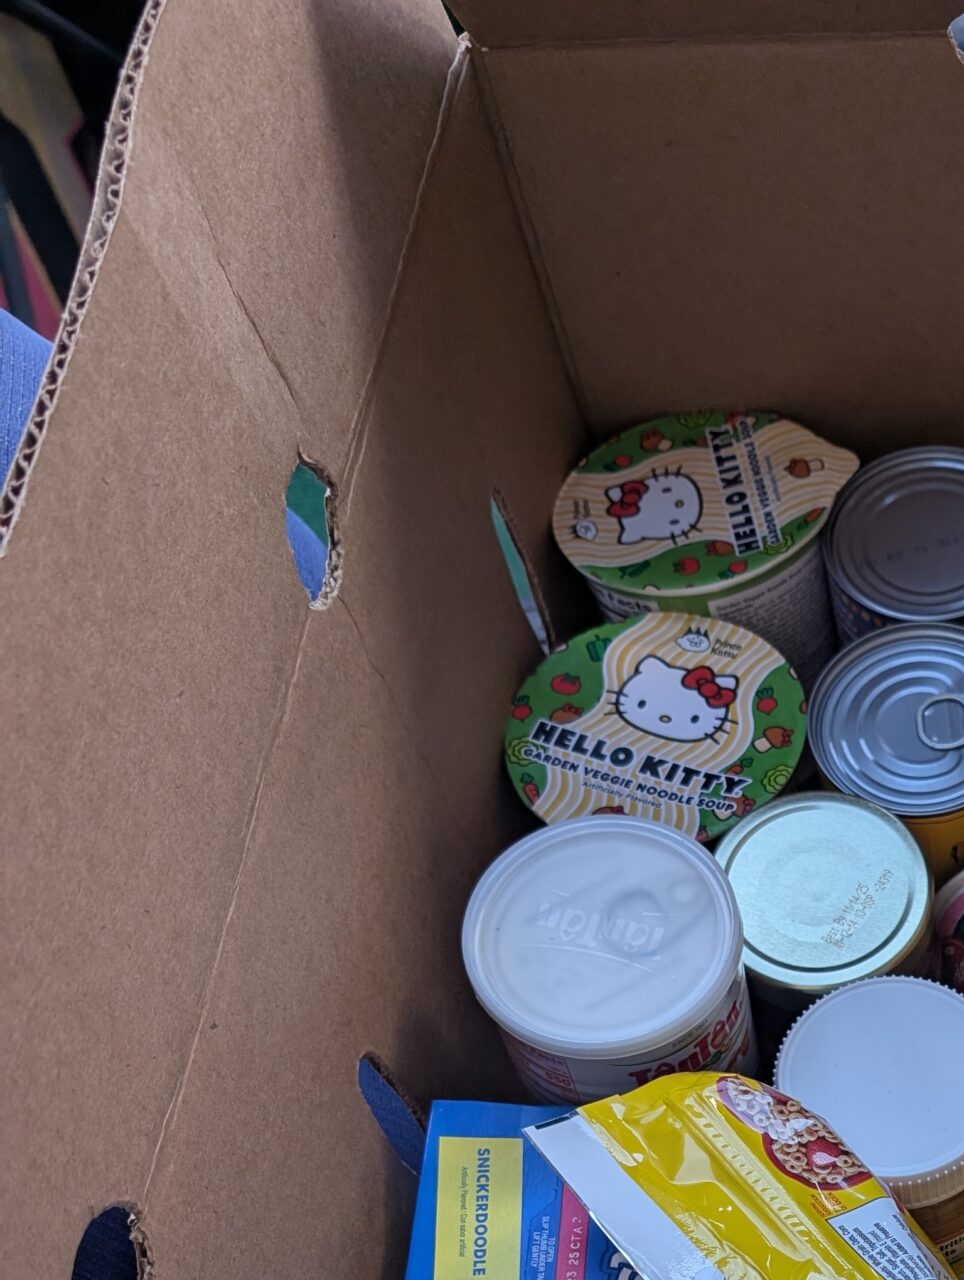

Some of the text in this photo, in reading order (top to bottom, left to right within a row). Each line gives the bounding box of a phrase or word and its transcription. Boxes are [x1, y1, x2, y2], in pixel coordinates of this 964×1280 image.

[709, 428, 762, 555] HELLO KITTY
[714, 638, 742, 651] Prince
[532, 721, 750, 797] HELLO KITTY
[523, 748, 736, 813] GARDEN VEGGIE NOODLE SOUP
[460, 1167, 469, 1190] Artificially
[460, 1190, 469, 1210] Flavored
[472, 1148, 491, 1277] SNICKERDOODLE
[530, 1231, 541, 1267] LIFT GENTLY
[540, 1230, 548, 1251] THUMB
[546, 1237, 556, 1262] TO OPEN
[538, 1252, 547, 1271] UNDER
